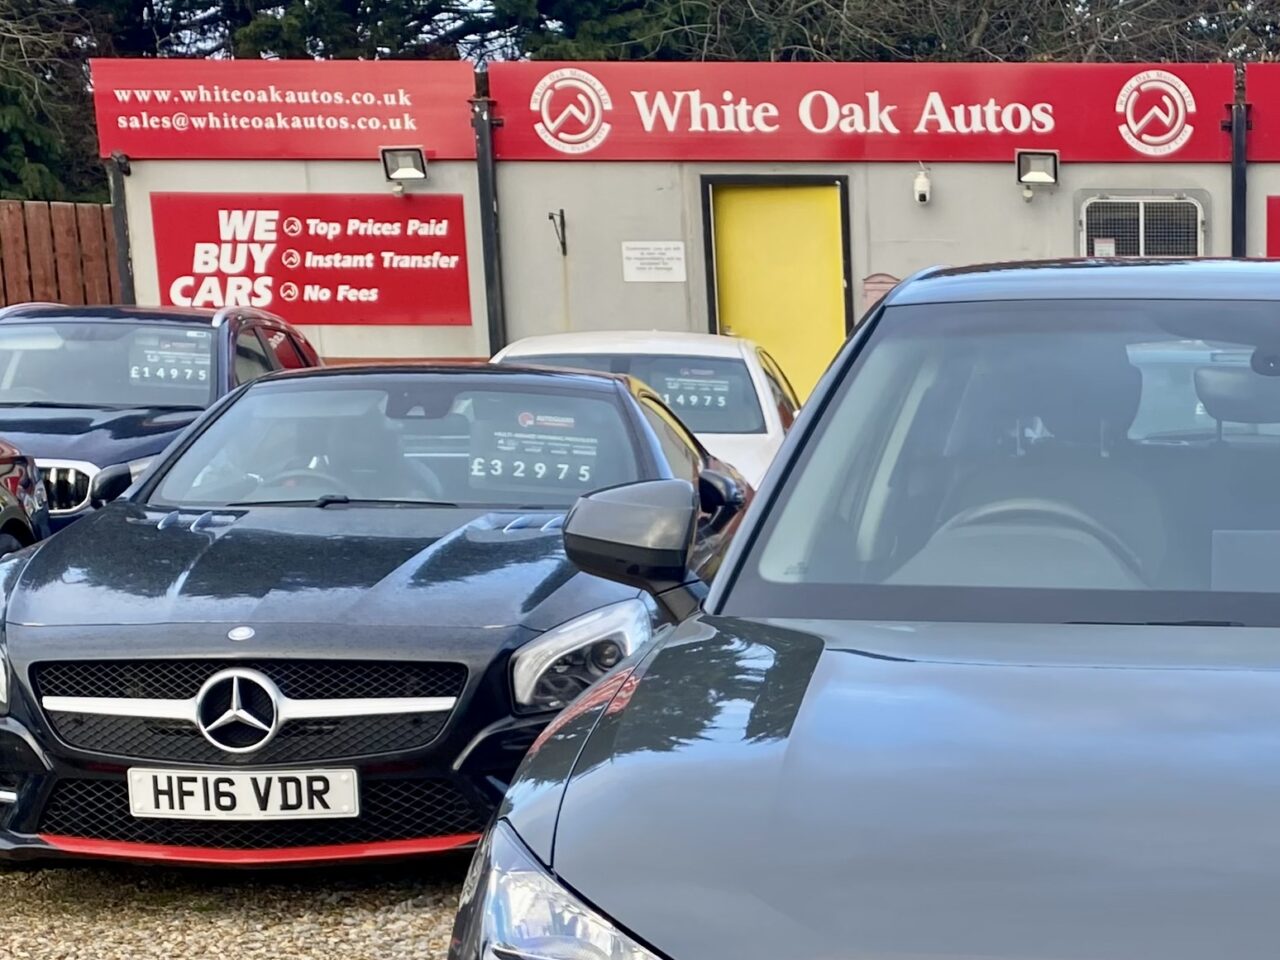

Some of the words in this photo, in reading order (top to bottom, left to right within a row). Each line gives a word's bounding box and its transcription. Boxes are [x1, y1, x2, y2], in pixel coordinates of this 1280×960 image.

[114, 85, 412, 107] www.whiteoakautos.co.uk
[117, 112, 417, 131] sales@whiteoakautos.co.uk
[631, 90, 779, 133] White
[799, 90, 899, 134] Oak
[914, 91, 1055, 134] Autos
[218, 209, 279, 241] WE
[306, 218, 341, 239] Top
[347, 218, 402, 236] Prices
[407, 219, 448, 236] Paid
[193, 243, 276, 274] BUY
[304, 251, 375, 268] Instant
[381, 251, 459, 268] Transfer
[169, 276, 272, 307] CARS
[303, 284, 331, 302] No
[336, 284, 379, 302] Fees
[130, 366, 206, 380] £14975
[471, 457, 590, 482] £32975
[152, 774, 237, 811] HF16
[251, 776, 330, 811] VDR
